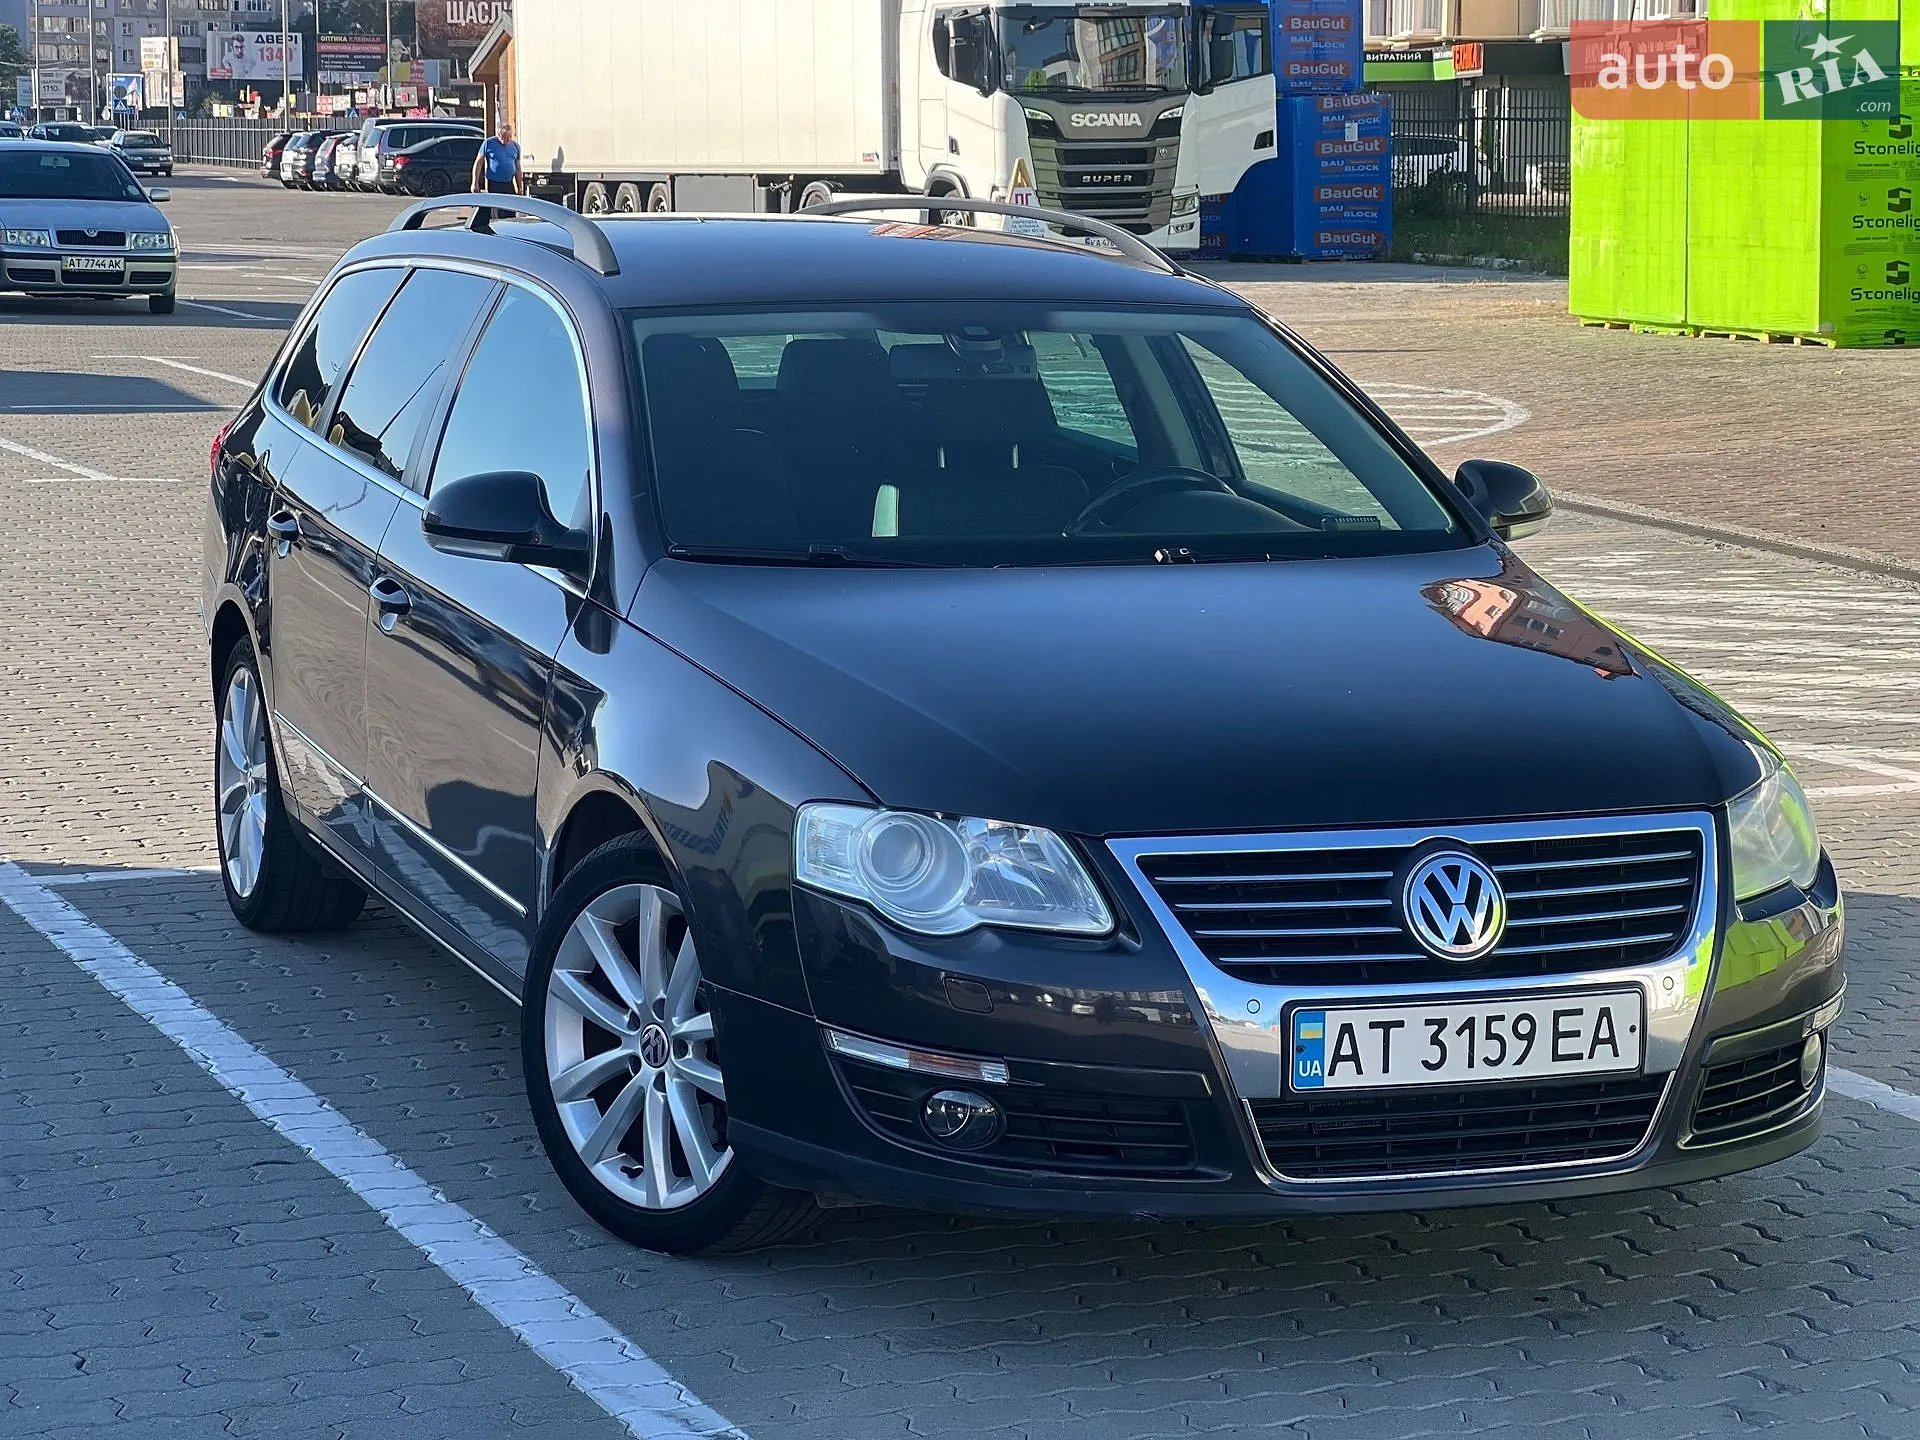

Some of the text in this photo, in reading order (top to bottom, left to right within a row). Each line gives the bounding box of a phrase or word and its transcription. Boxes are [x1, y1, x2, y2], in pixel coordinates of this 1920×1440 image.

[446, 0, 512, 26] ЩАСЛ
[1290, 18, 1346, 29] BauGut
[320, 35, 348, 43] ОПТИКА
[1366, 52, 1422, 61] ВИТРАТНИЙ
[1289, 64, 1345, 75] BauGut
[1071, 113, 1142, 127] SCANIA
[1320, 140, 1380, 154] BauGut
[1344, 164, 1380, 172] BLOCK
[1082, 174, 1133, 183] SUPER
[1320, 187, 1379, 199] BauGut
[1320, 232, 1377, 245] BauGut
[68, 258, 122, 269] AT 7744 AK
[1327, 1006, 1621, 1077] AT 3159 EA
[1299, 1060, 1322, 1077] UA
